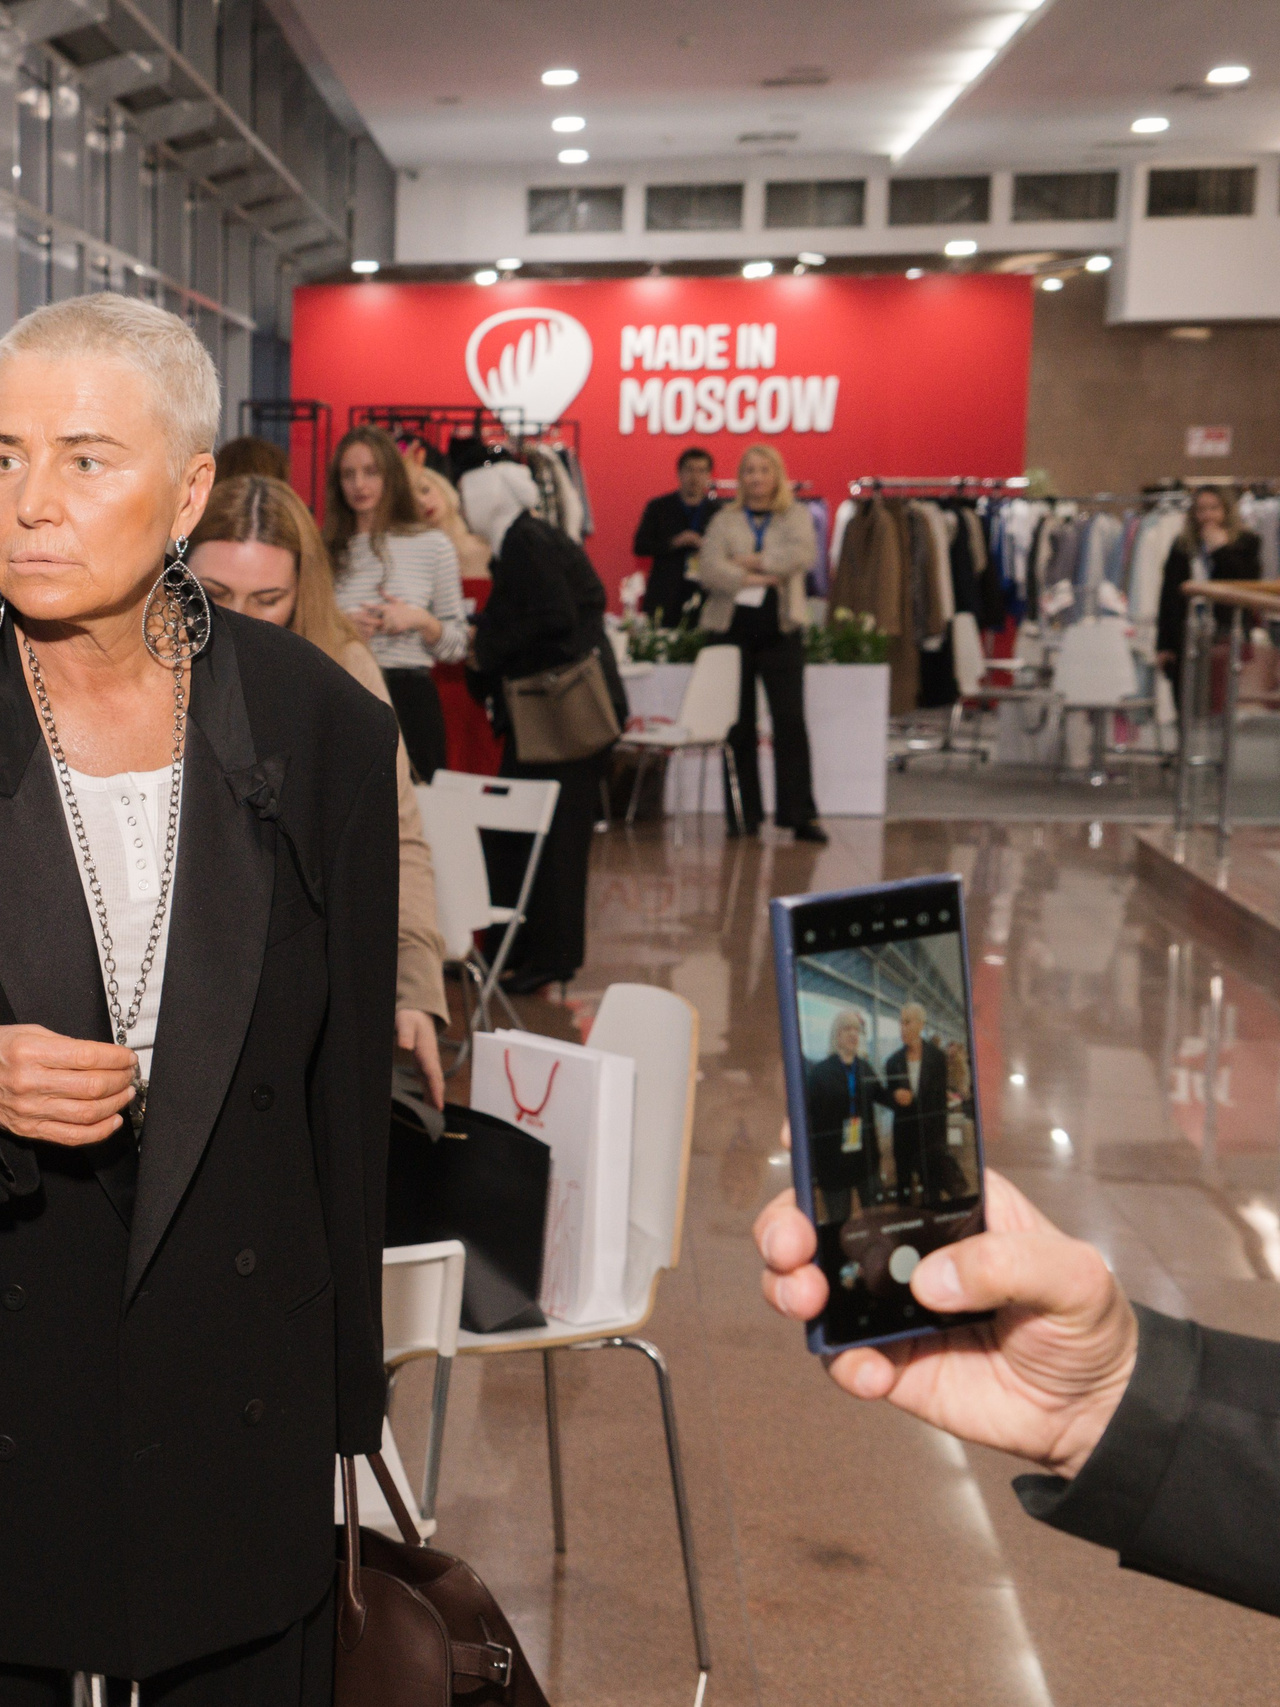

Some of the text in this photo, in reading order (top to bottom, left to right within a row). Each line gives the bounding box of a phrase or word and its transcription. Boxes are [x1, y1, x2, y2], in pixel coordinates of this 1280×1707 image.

[620, 322, 777, 371] MADE IN
[619, 375, 840, 435] MOSCOW
